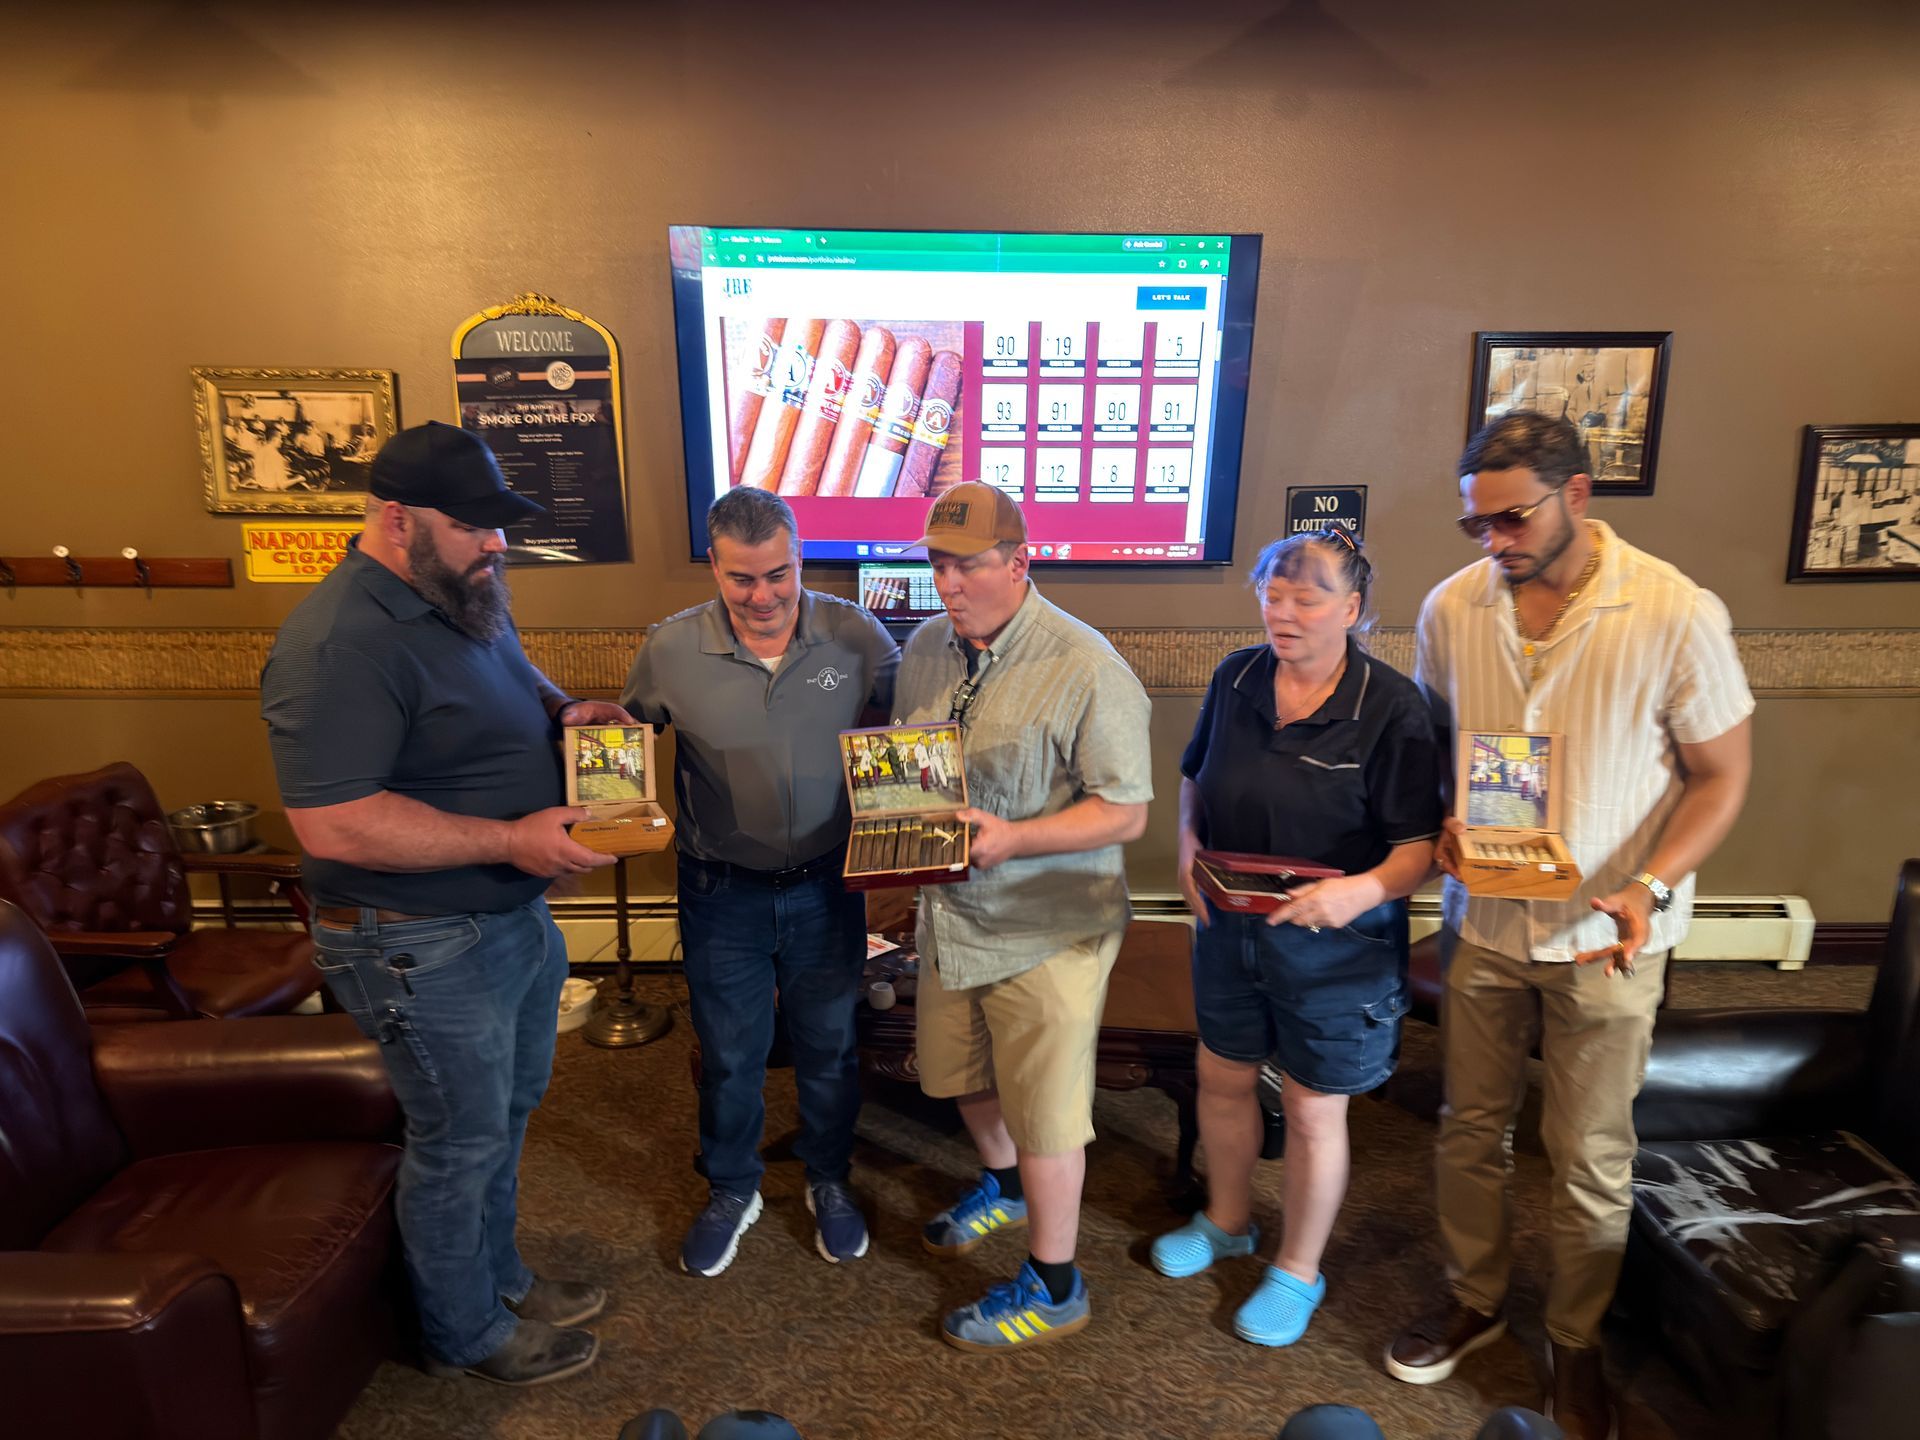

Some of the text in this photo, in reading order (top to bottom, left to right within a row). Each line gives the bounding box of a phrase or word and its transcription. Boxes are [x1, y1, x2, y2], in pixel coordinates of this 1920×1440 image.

[495, 330, 574, 352] WELCOME
[996, 336, 1015, 356] 90
[478, 413, 597, 425] SMOKE ON THE FOX
[996, 401, 1012, 421] 93
[1051, 401, 1068, 421] 91
[1108, 402, 1127, 421] 90
[1164, 402, 1181, 421] 91
[1313, 495, 1339, 513] NO
[1293, 518, 1357, 532] LOITNG
[251, 531, 355, 551] NAPOLEO
